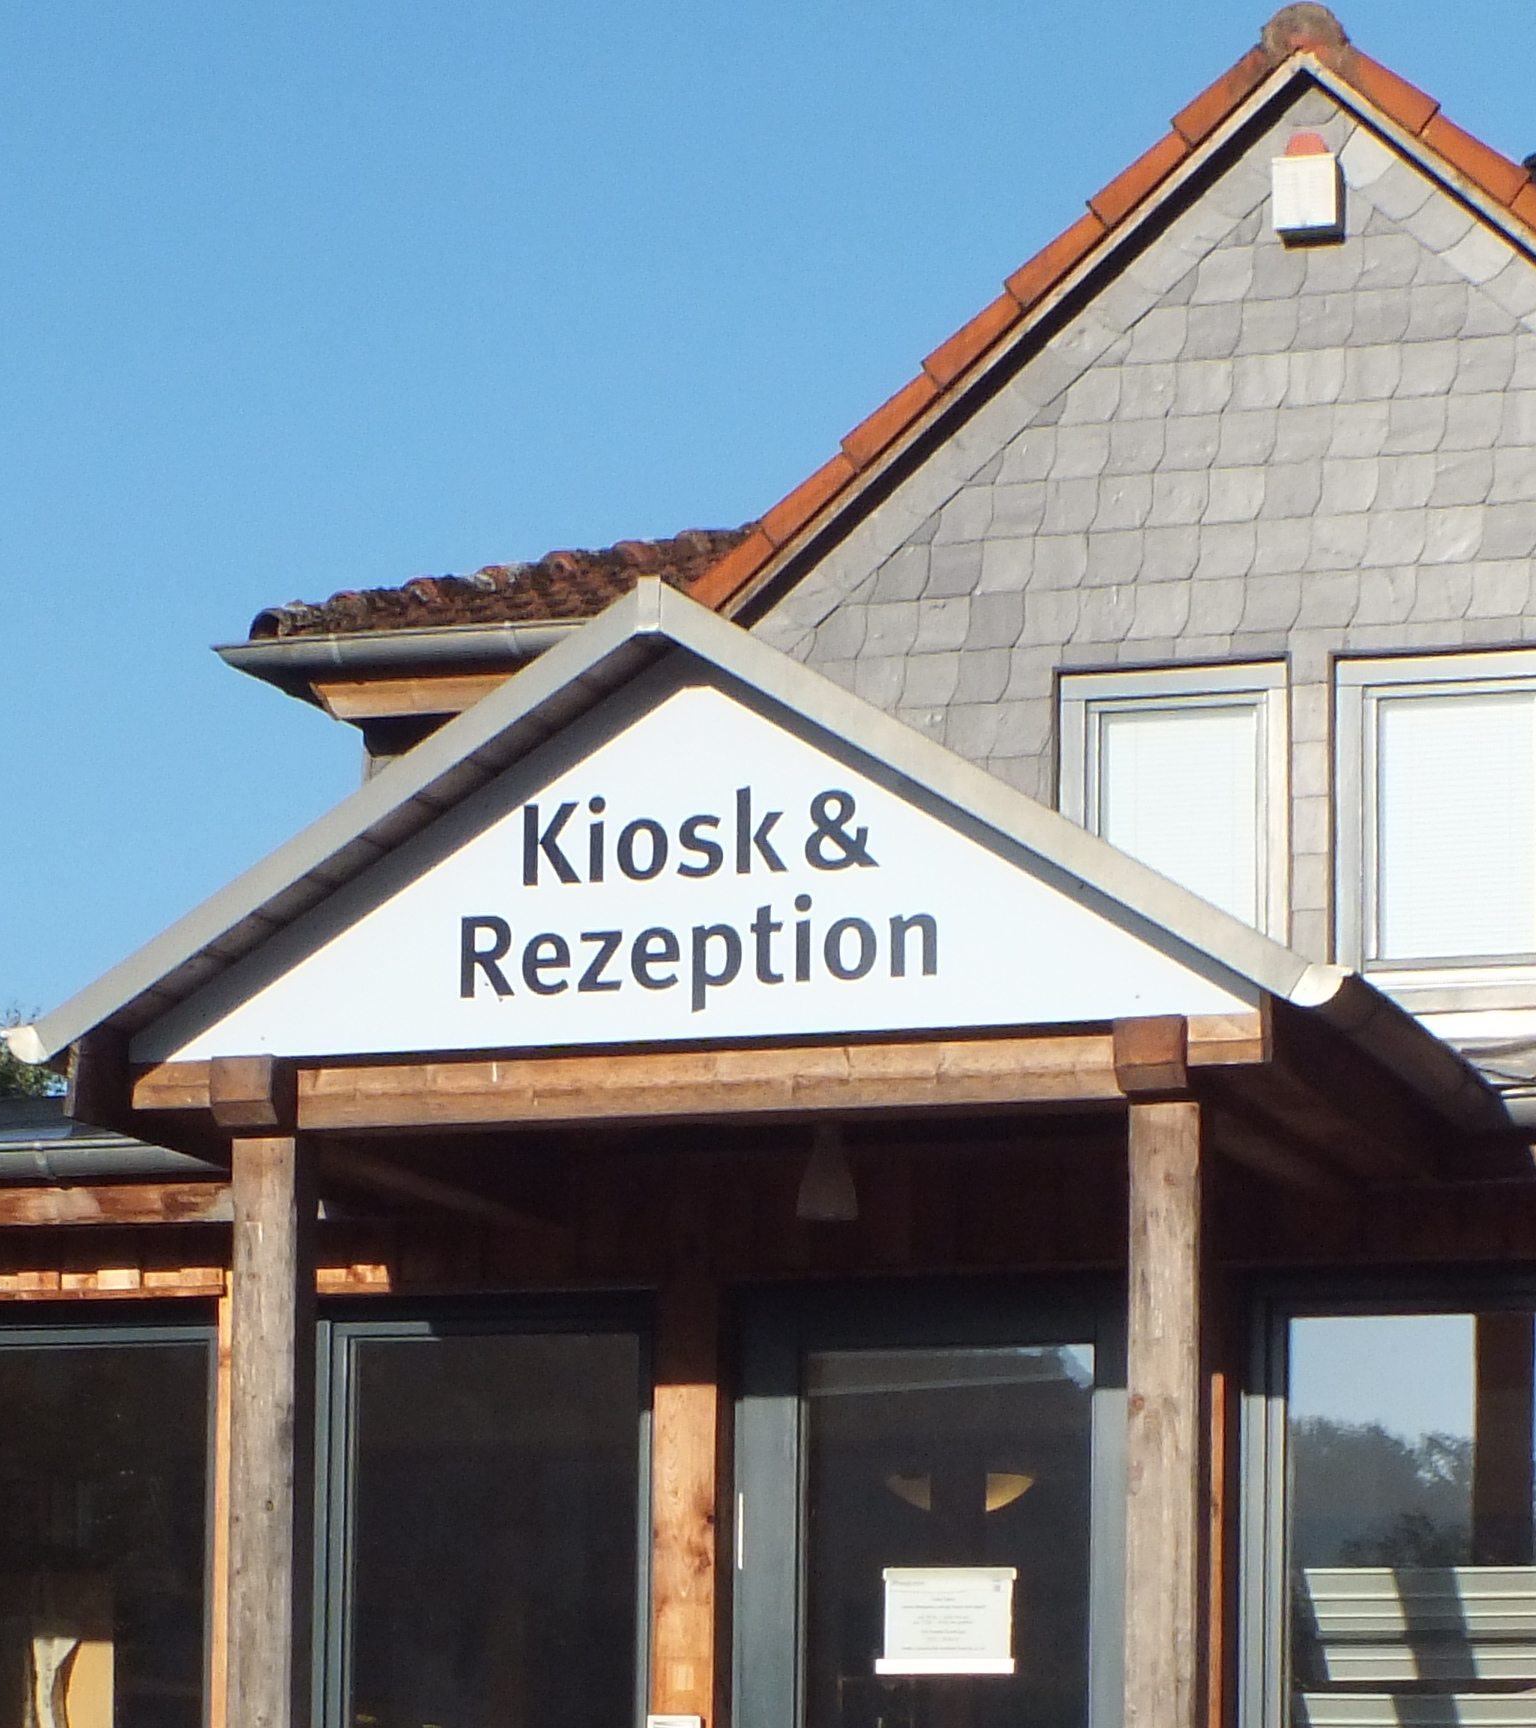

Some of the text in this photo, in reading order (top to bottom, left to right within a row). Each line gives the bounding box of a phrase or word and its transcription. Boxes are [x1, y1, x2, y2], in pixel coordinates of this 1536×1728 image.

[522, 785, 880, 886] Kiosk &
[460, 893, 938, 1013] Rezeption
